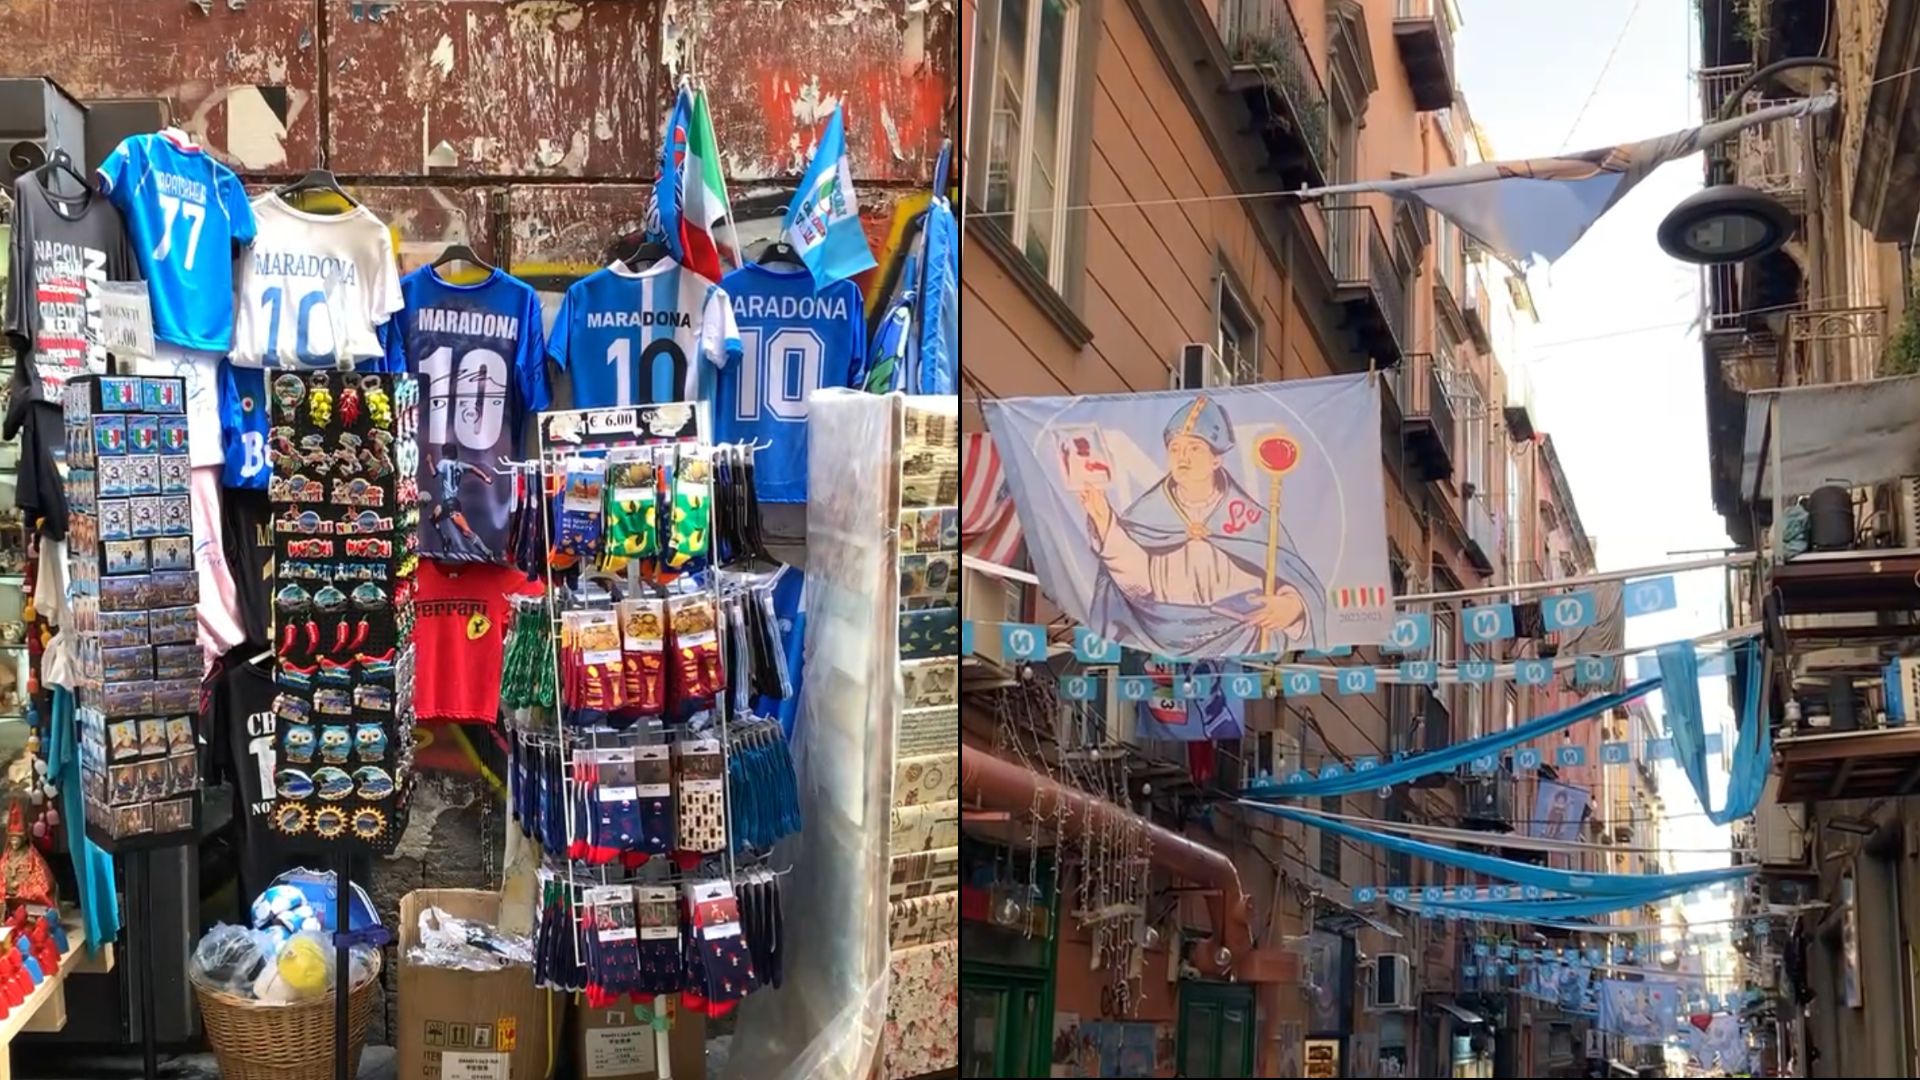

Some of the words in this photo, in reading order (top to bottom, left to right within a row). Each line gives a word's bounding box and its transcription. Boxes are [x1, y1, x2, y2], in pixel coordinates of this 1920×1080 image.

[152, 193, 206, 270] 77
[34, 240, 83, 263] NAPOLI
[256, 252, 355, 286] MARADONA
[734, 295, 848, 320] ARADONA
[419, 308, 519, 341] MARADONA
[587, 311, 692, 328] MARADONA
[607, 338, 688, 406] 10
[736, 326, 825, 422] 10
[419, 346, 508, 450] 10
[589, 416, 597, 428] €
[605, 413, 632, 427] 6.00
[110, 466, 119, 480] 3
[140, 465, 149, 478] 3
[171, 465, 180, 478] 3
[110, 511, 119, 524] 3
[141, 507, 150, 520] 3
[171, 506, 180, 519] 3
